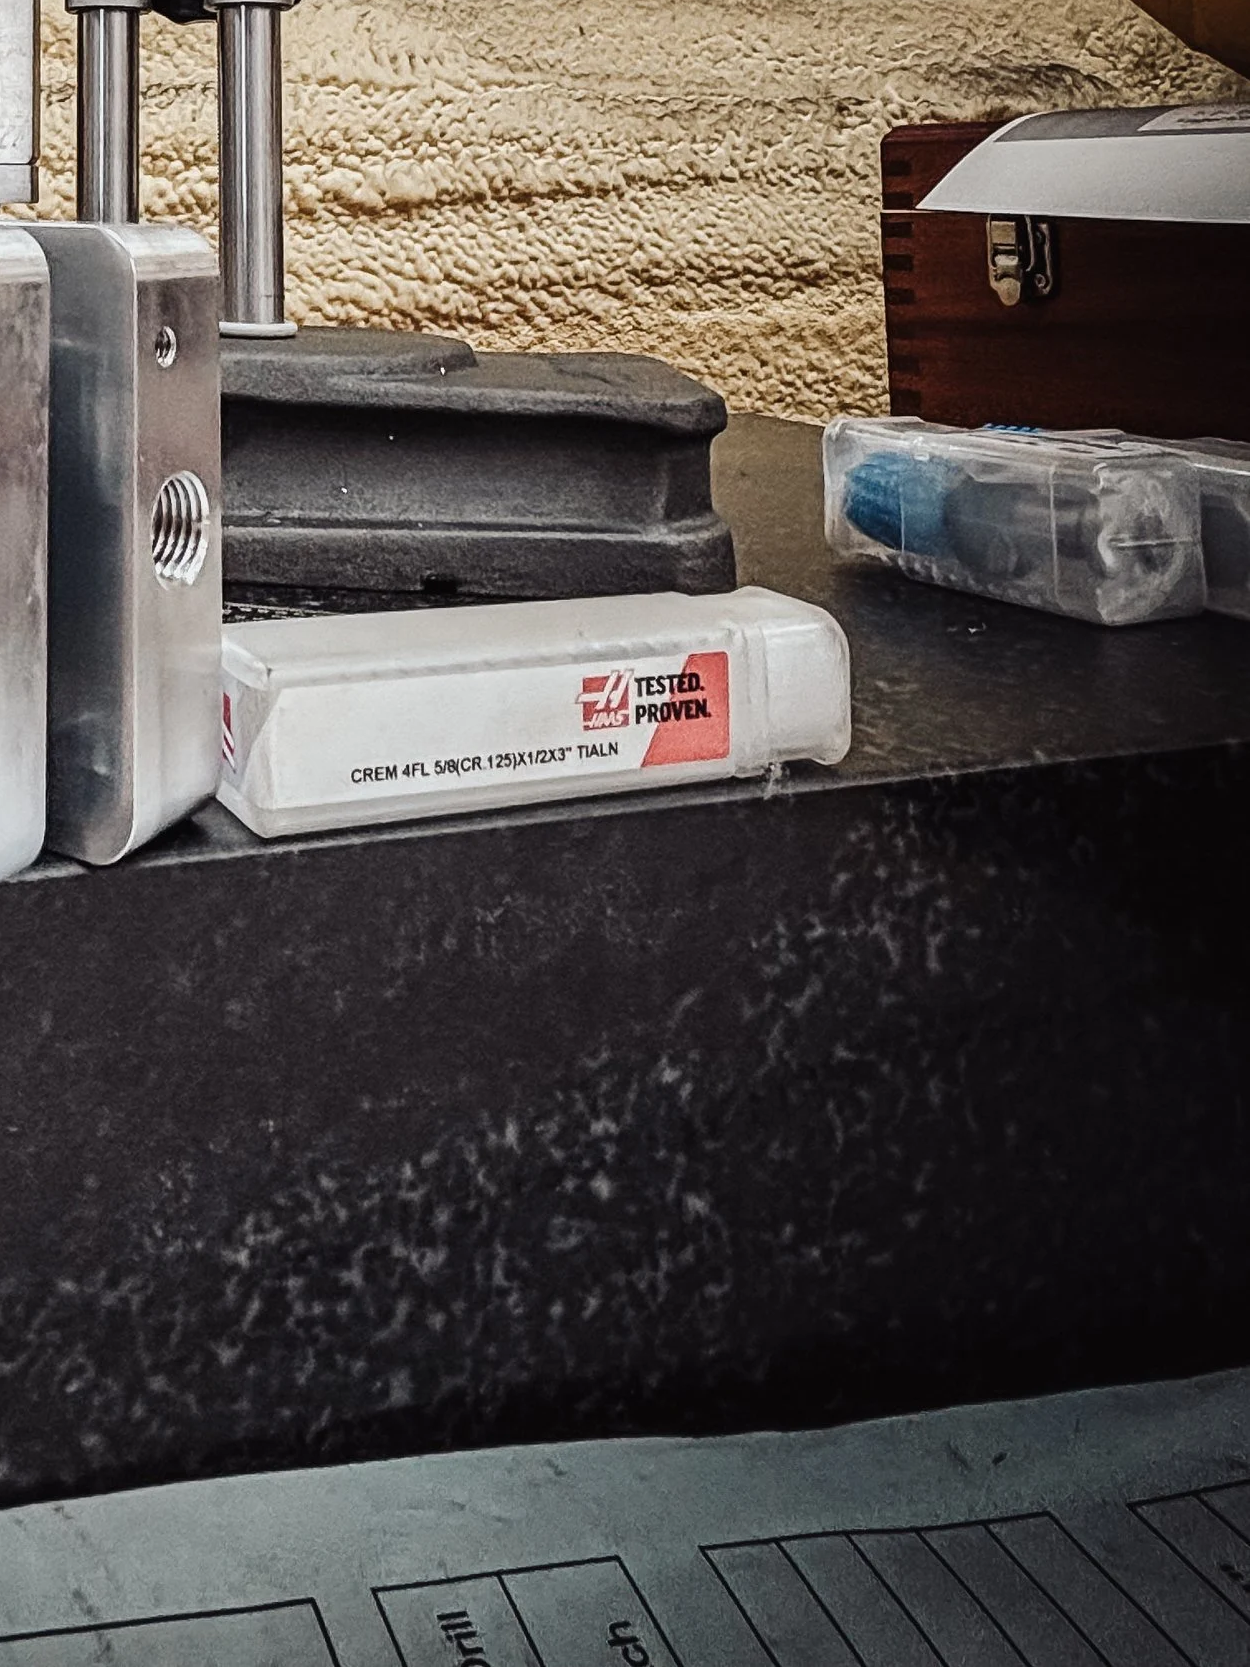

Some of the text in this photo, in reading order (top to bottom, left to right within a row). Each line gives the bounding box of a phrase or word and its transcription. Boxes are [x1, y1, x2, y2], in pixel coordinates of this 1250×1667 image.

[634, 672, 705, 698] TESTED.
[635, 699, 712, 725] PROVEN.
[351, 764, 398, 783] CREM
[402, 762, 430, 777] 4FL
[577, 742, 619, 759] TIALN
